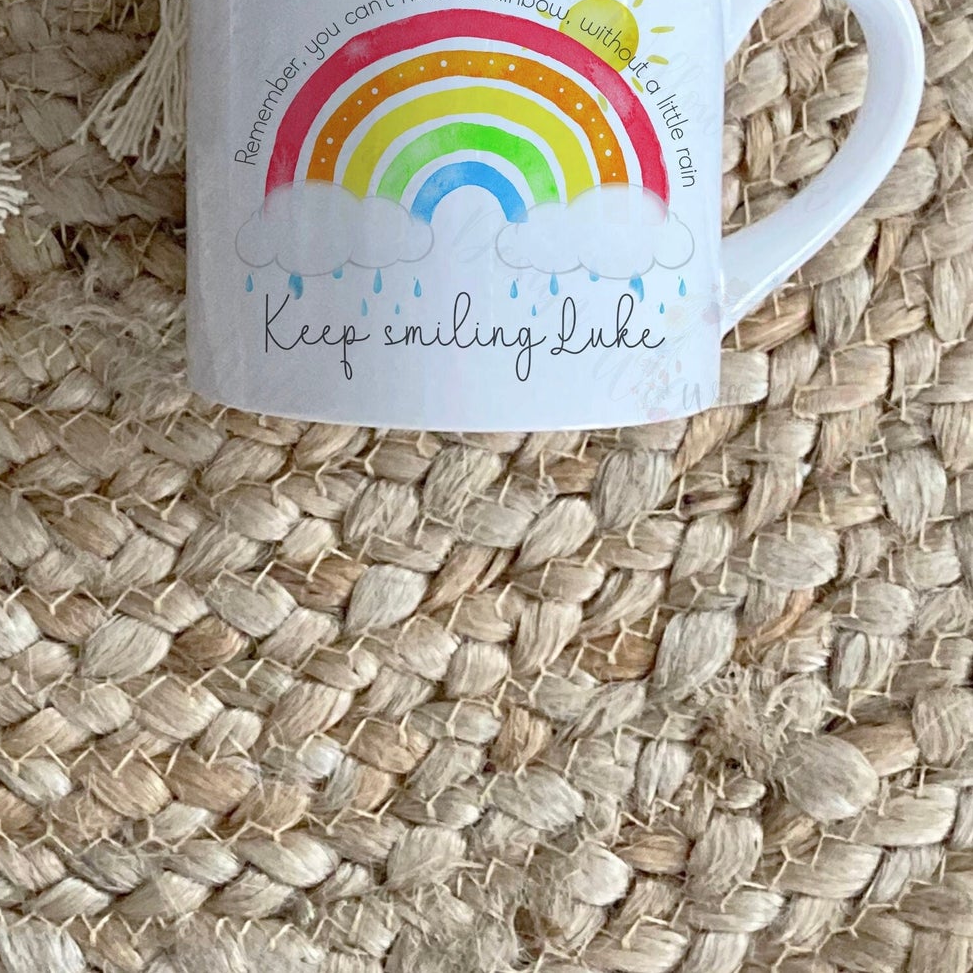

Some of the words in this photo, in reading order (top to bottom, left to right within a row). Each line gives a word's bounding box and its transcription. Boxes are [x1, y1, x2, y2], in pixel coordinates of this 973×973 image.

[234, 56, 309, 166] Remember,
[304, 22, 340, 60] you
[579, 17, 650, 82] without
[646, 79, 661, 96] a
[657, 94, 689, 141] little
[676, 147, 696, 188] rain
[265, 292, 370, 380] Keep
[384, 292, 546, 381] smiling
[550, 293, 665, 355] Luke
